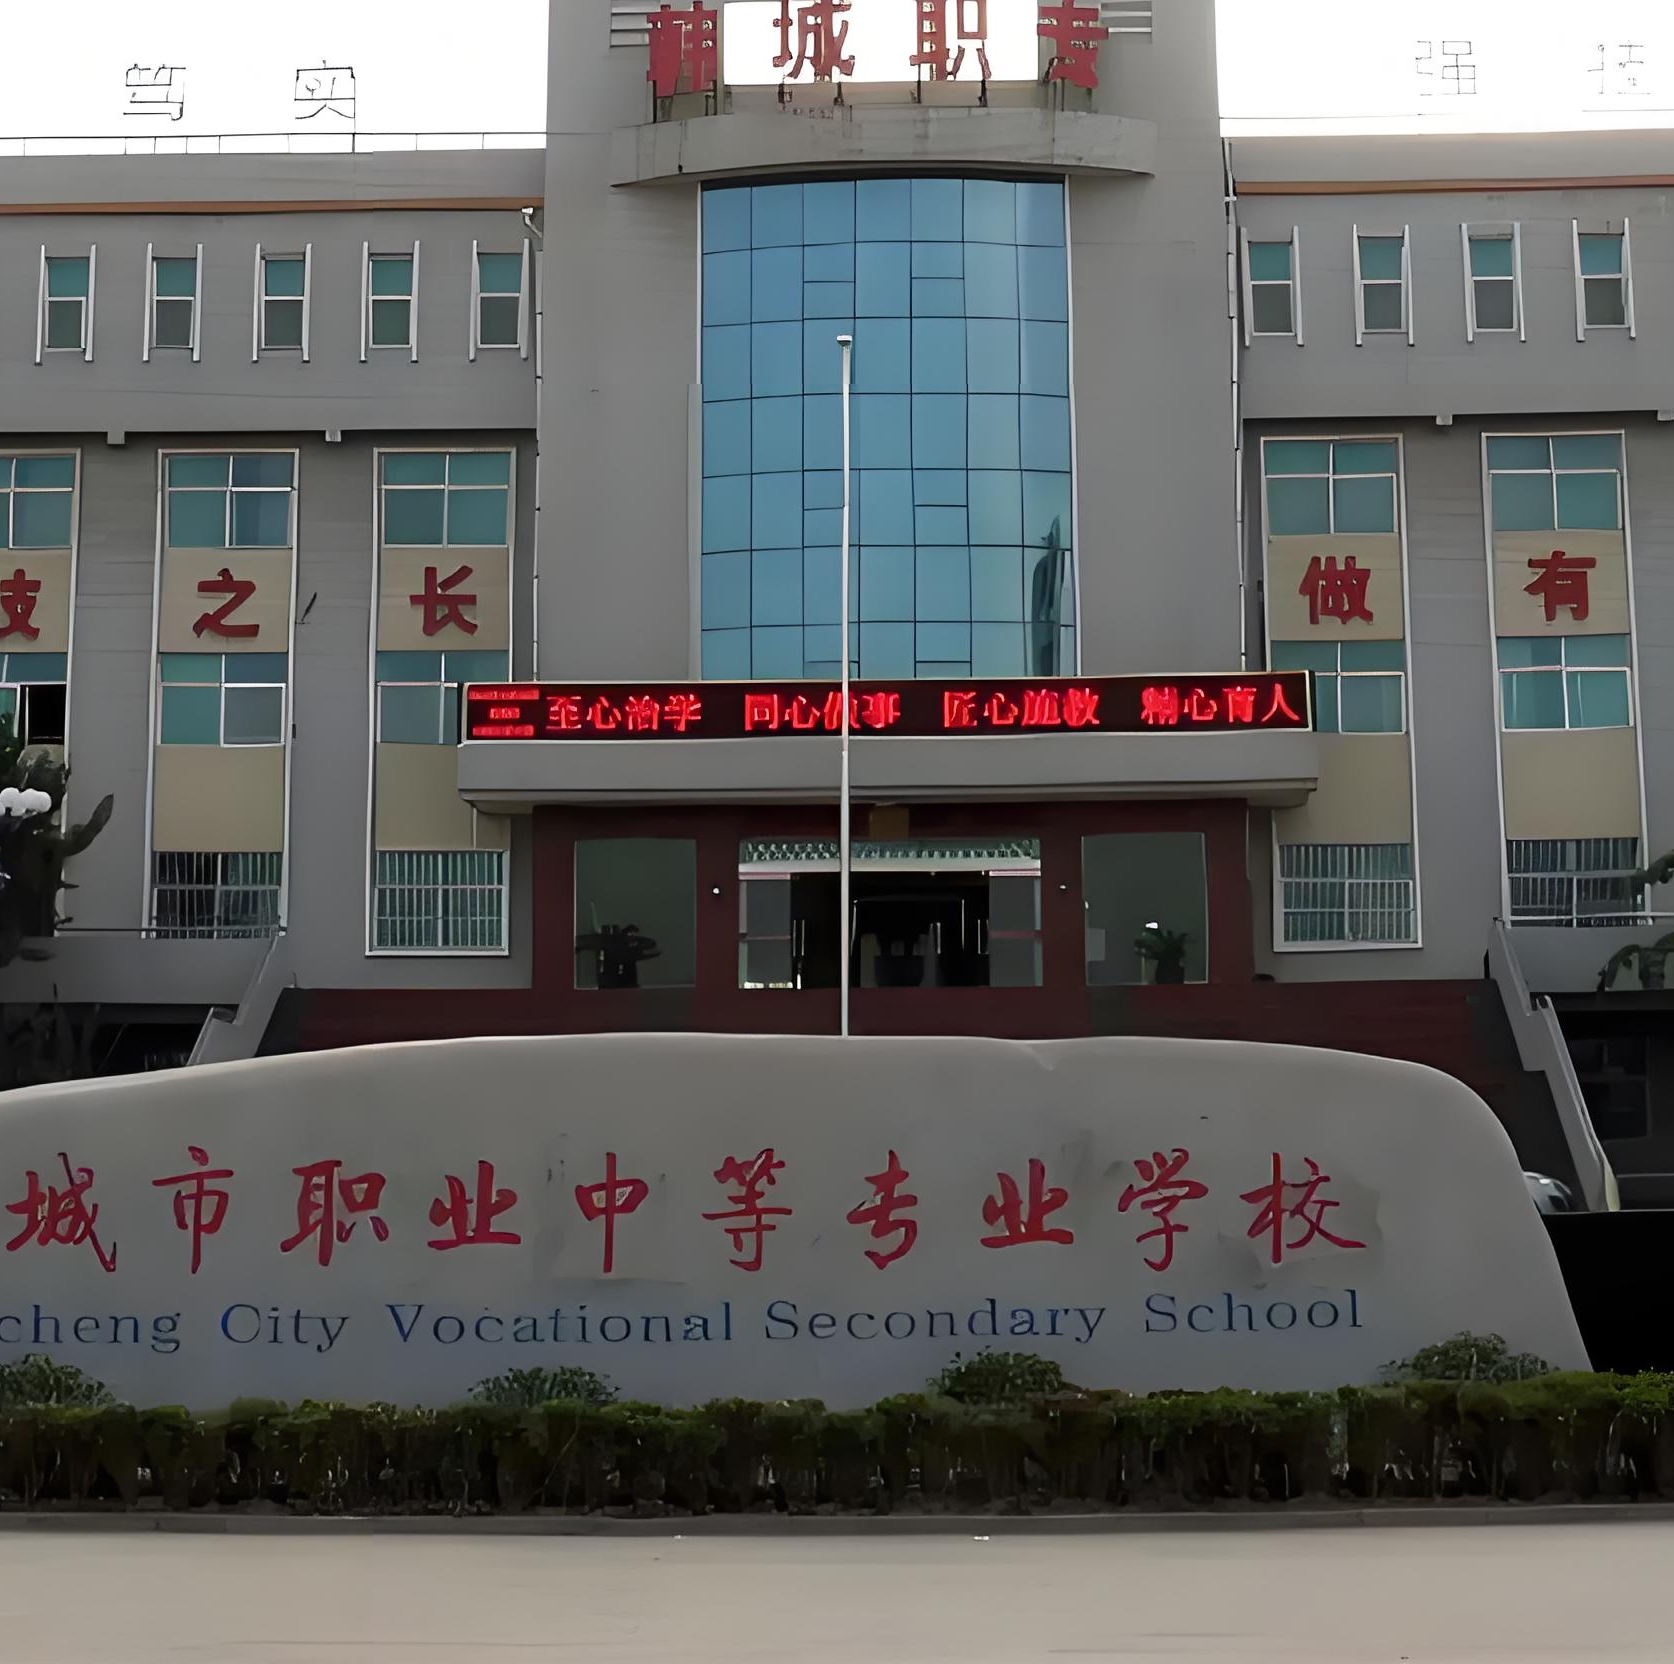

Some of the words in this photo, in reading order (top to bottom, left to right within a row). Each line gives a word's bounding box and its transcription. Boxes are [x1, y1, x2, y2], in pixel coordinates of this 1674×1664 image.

[219, 1303, 351, 1353] City
[385, 1301, 733, 1344] Vocational
[765, 1297, 1107, 1344] Secondary
[1145, 1288, 1364, 1334] School
